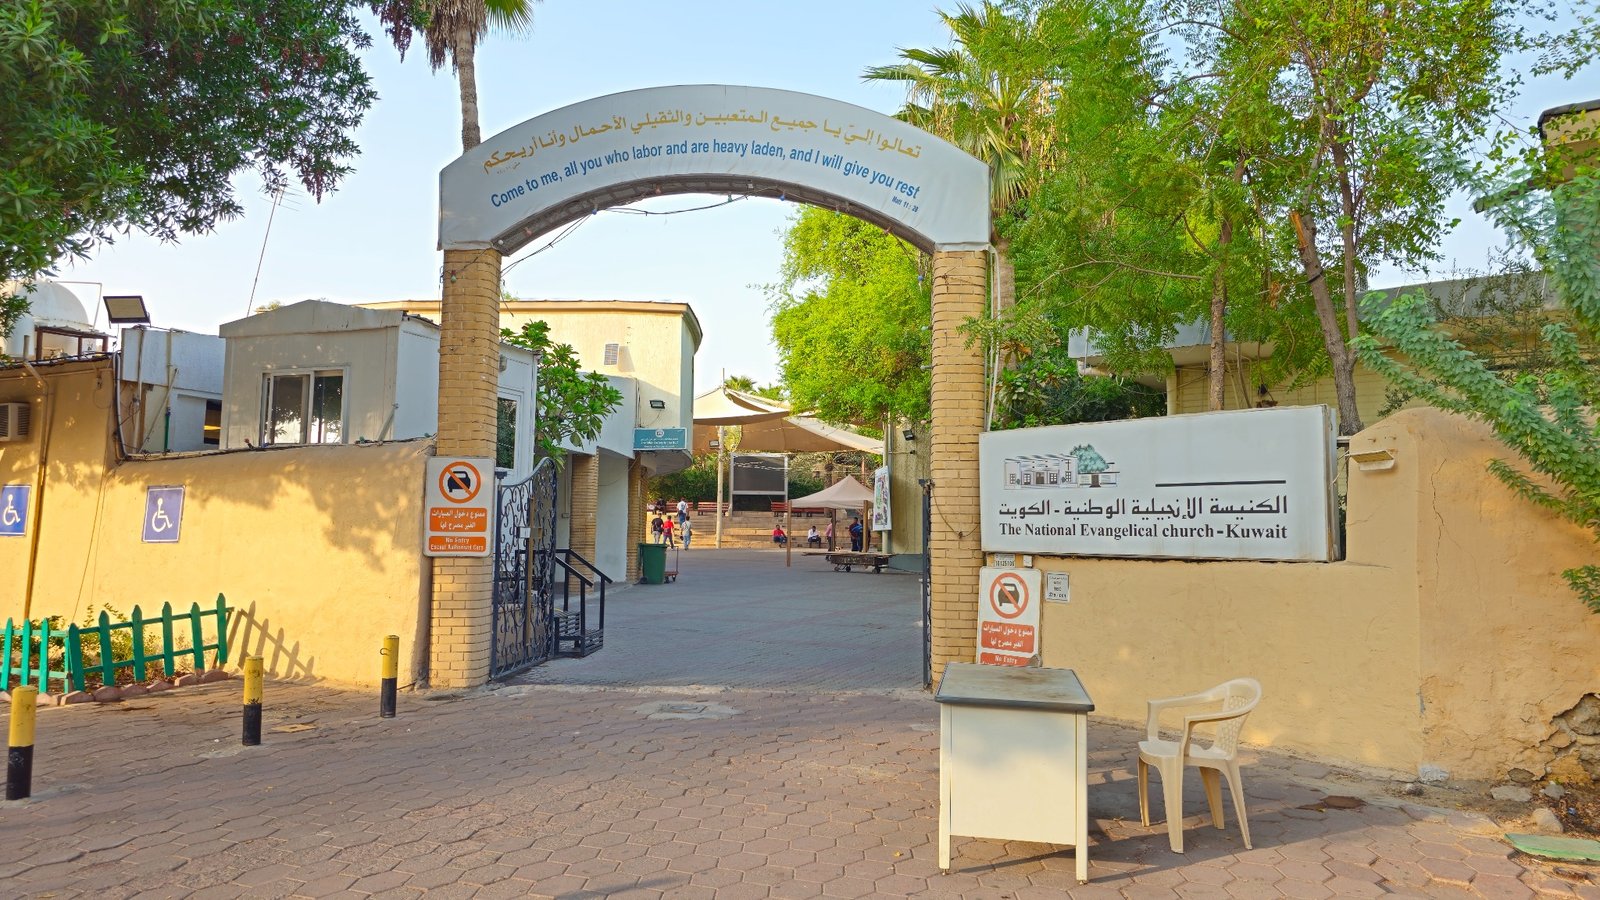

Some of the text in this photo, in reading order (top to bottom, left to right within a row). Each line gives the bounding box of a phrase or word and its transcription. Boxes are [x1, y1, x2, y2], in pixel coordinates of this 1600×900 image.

[630, 109, 691, 135] والثقيلي
[695, 109, 768, 126] المتعبين
[770, 115, 817, 132] جميع
[823, 119, 841, 138] يا
[569, 115, 627, 143] الأحمال
[876, 133, 921, 158] تعالوا
[491, 139, 921, 208] Come to me, all you who labor and are heavy laden, and I will give you rest
[999, 500, 1050, 519] الكويت
[1064, 498, 1125, 520] الوطنية
[1131, 496, 1203, 520] الإنجيلية
[1210, 495, 1287, 520] الكنيسة
[1000, 523, 1021, 535] The
[1025, 524, 1076, 536] National
[1080, 523, 1158, 540] Evangelical
[1003, 656, 1017, 664] Entry
